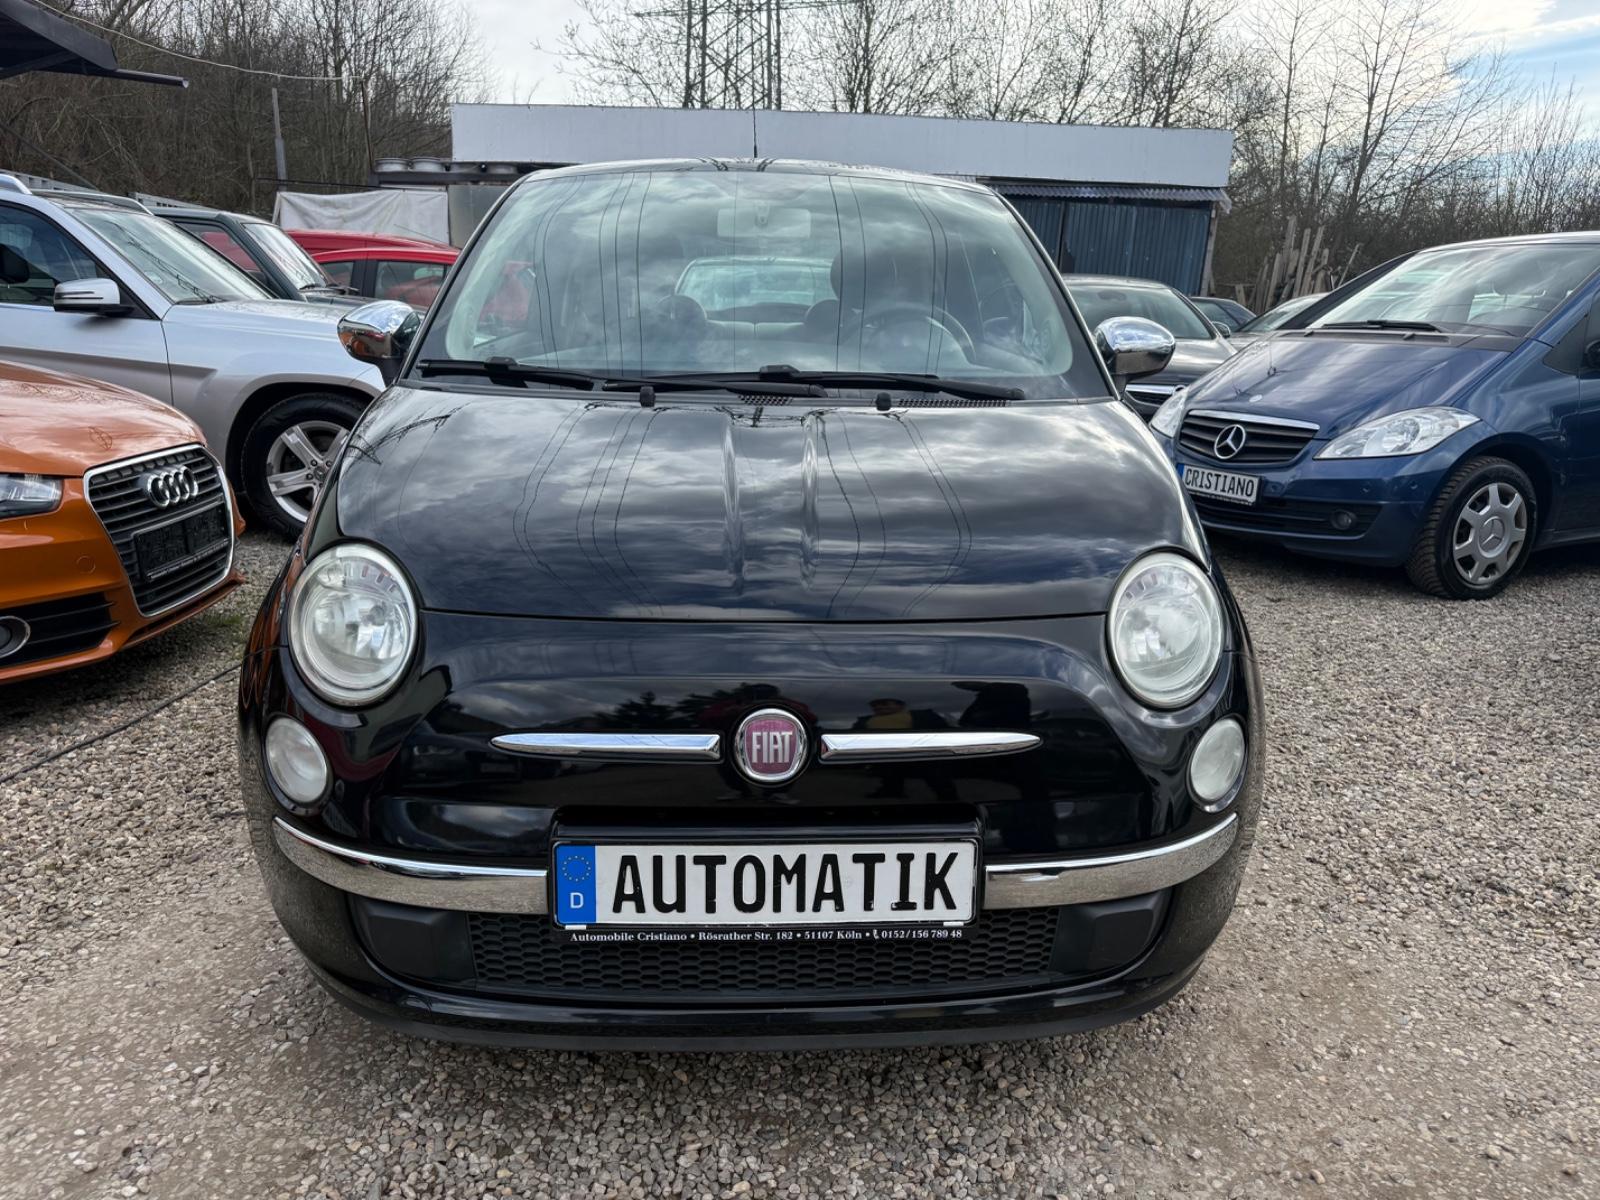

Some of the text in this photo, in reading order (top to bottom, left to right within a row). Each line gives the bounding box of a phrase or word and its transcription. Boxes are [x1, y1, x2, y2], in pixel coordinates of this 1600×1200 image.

[1185, 468, 1254, 498] CRISTIANO
[751, 731, 793, 764] FIAT
[612, 852, 959, 914] AUTOMATIK
[569, 892, 584, 909] D
[570, 932, 635, 942] Automobile
[637, 932, 688, 941] Cristiano
[698, 931, 753, 941] Rösrather
[754, 931, 773, 941] Str.
[776, 931, 793, 940] 182
[804, 930, 834, 940] 51107
[837, 930, 862, 940] Köln
